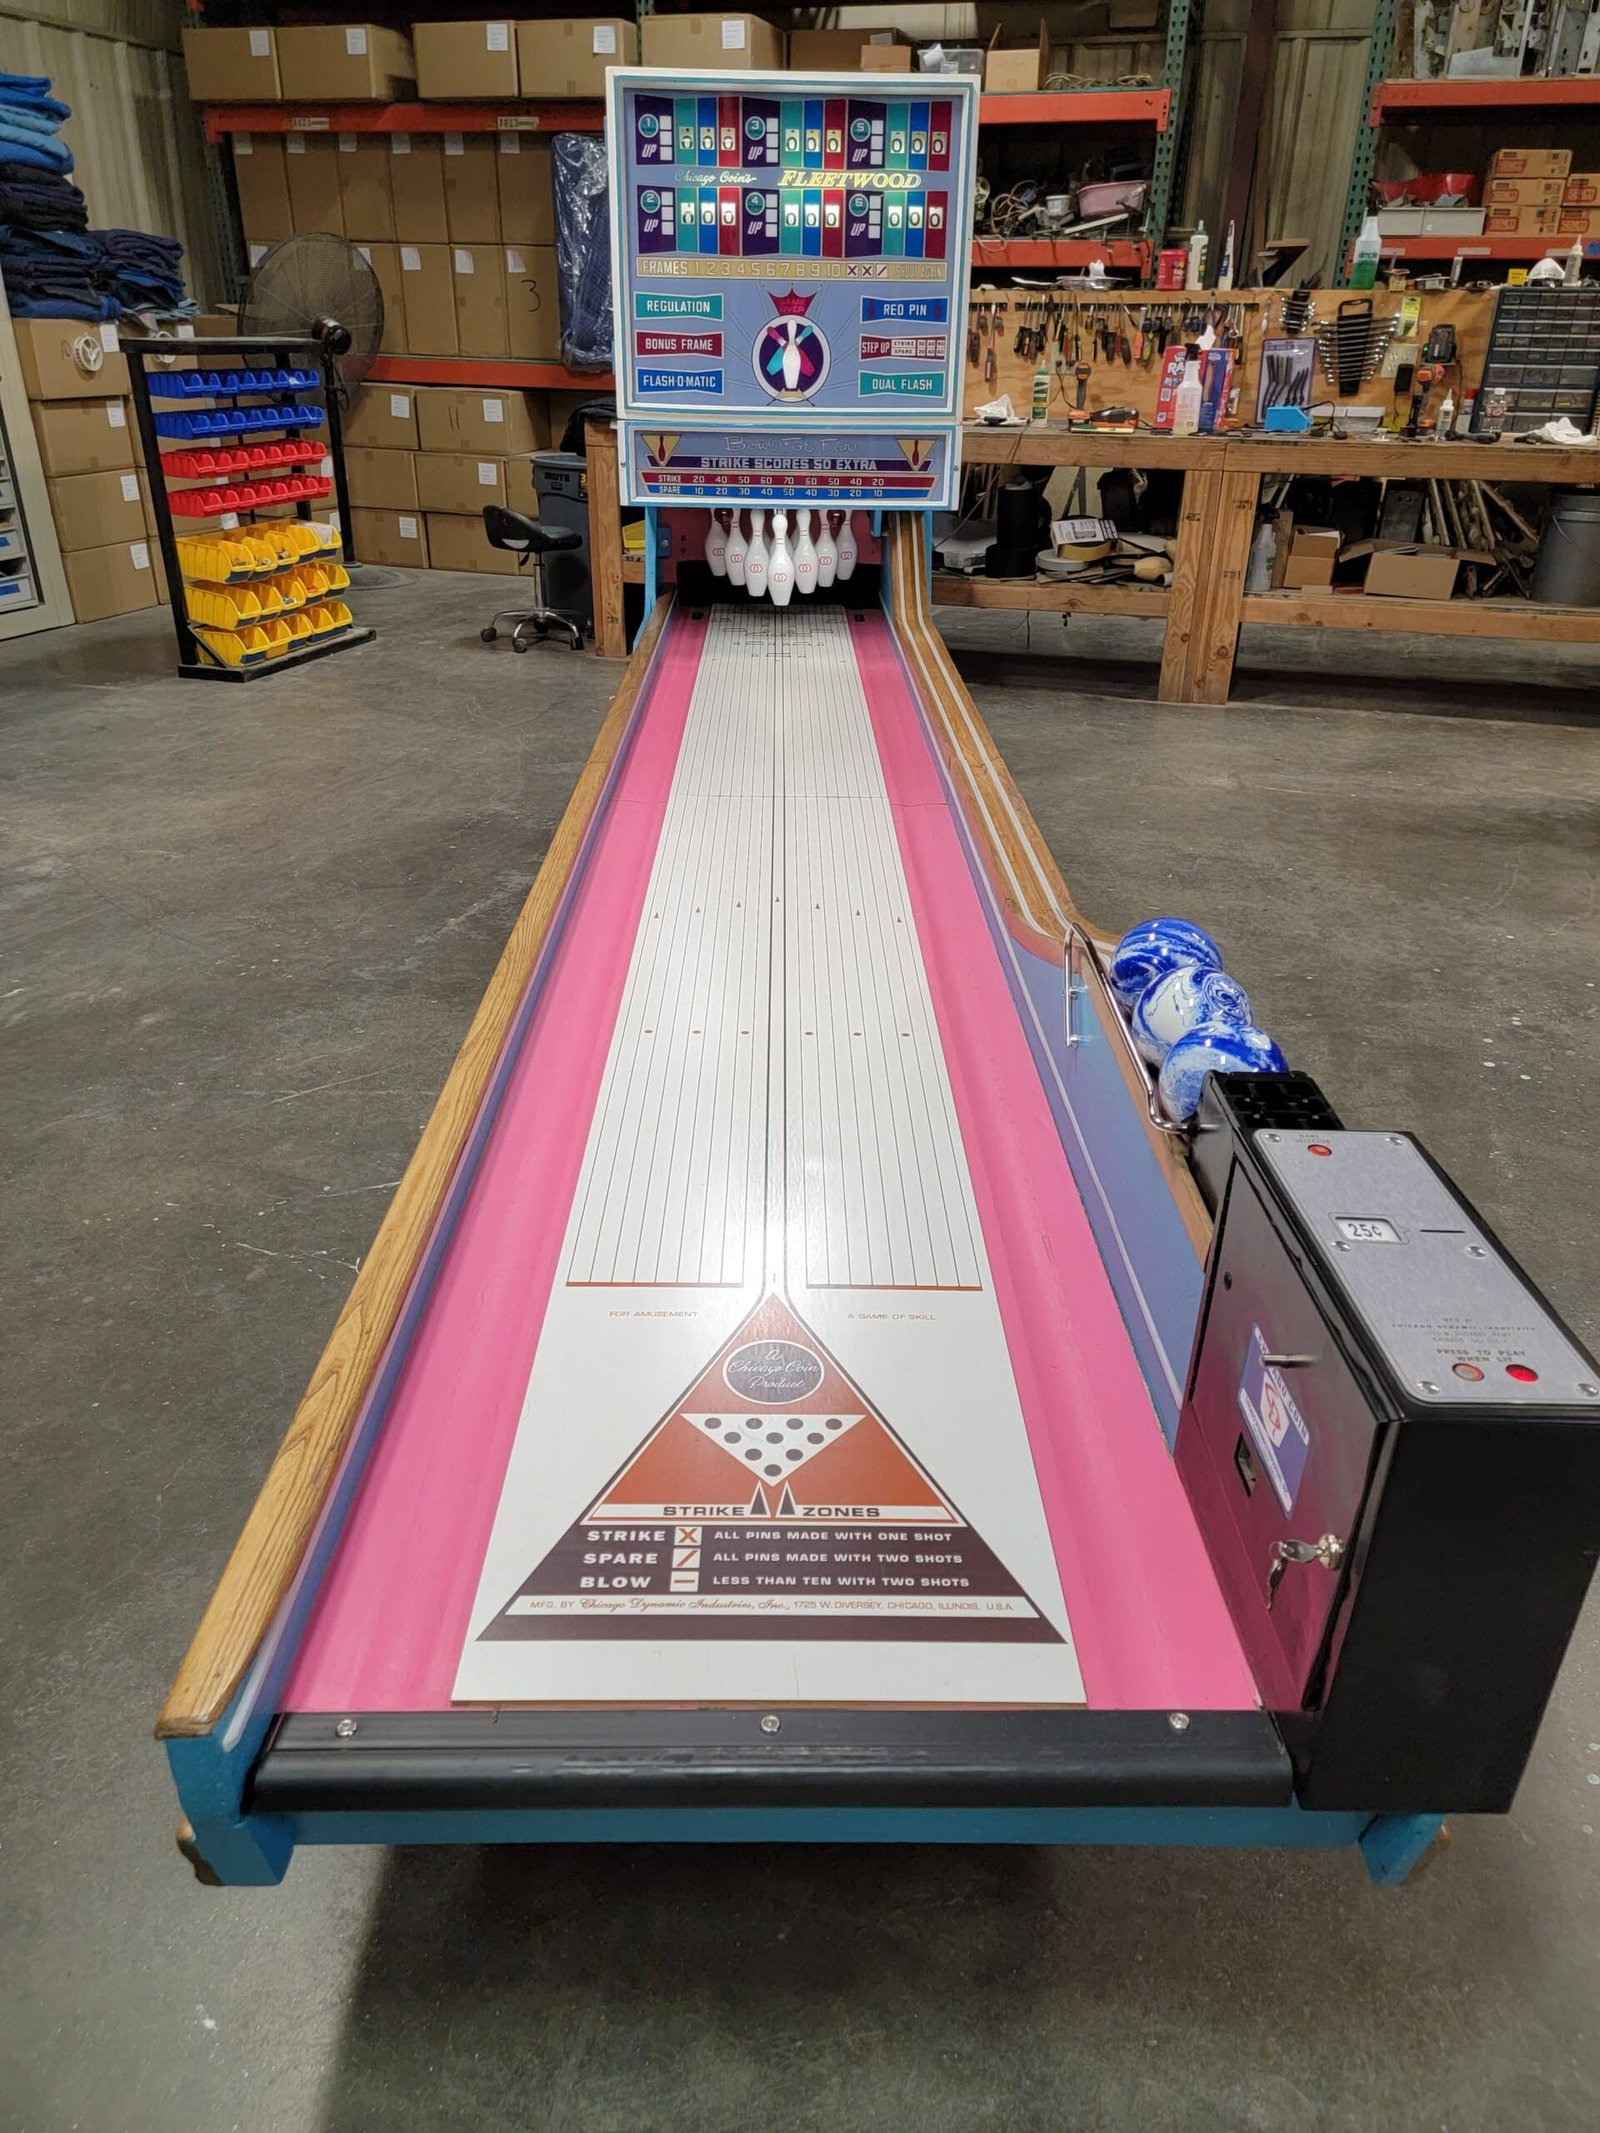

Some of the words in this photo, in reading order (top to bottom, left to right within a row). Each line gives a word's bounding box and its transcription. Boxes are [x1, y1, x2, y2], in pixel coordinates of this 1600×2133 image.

[751, 121, 759, 130] 3
[786, 137, 797, 150] 0
[807, 138, 817, 150] 0
[828, 138, 838, 151] 0
[892, 138, 902, 152] 0
[912, 138, 923, 152] 0
[933, 139, 943, 153] 0
[642, 144, 657, 158] UP
[748, 146, 763, 160] UP
[852, 149, 868, 162] UP
[675, 170, 716, 186] Chicago
[778, 170, 922, 188] FLEETWOOD
[646, 194, 654, 202] 2
[751, 196, 759, 204] 4
[703, 211, 714, 224] 0
[786, 212, 797, 226] 0
[806, 212, 817, 226] 0
[826, 213, 837, 226] 0
[890, 214, 900, 227] 0
[910, 212, 920, 226] 0
[930, 214, 940, 227] 0
[644, 219, 658, 232] UP
[748, 222, 763, 234] UP
[850, 223, 866, 236] UP
[643, 260, 688, 275] FRAMES
[706, 262, 716, 276] 2
[721, 262, 730, 276] 3
[737, 262, 745, 276] 4
[752, 262, 760, 276] 5
[766, 262, 775, 276] 6
[782, 262, 790, 276] 7
[796, 264, 805, 276] 8
[811, 264, 820, 276] 9
[827, 264, 840, 276] 10
[647, 300, 710, 312] REGULATION
[884, 304, 904, 316] RED
[909, 304, 927, 316] PIN
[646, 338, 677, 350] BONUS
[682, 339, 713, 350] FRAME
[862, 342, 879, 354] STEP
[880, 342, 890, 354] UP
[872, 378, 897, 390] DUAL
[901, 378, 932, 390] FLASH
[700, 457, 750, 468] STRIKE
[754, 458, 809, 470] SCORES
[814, 459, 832, 470] 50
[836, 460, 878, 470] EXTRA
[658, 474, 682, 483] STRIKE
[715, 476, 728, 484] 40
[738, 476, 750, 484] 50
[760, 476, 772, 484] 60
[828, 478, 840, 486] 50
[850, 478, 862, 486] 40
[872, 478, 884, 486] 20
[659, 486, 680, 494] SPARE
[739, 488, 750, 496] 30
[760, 488, 772, 496] 40
[783, 488, 794, 496] 50
[805, 488, 818, 496] 40
[828, 489, 840, 497] 30
[850, 489, 862, 497] 20
[874, 489, 882, 497] 10
[1348, 1223, 1382, 1238] 25¢
[728, 1360, 783, 1376] Chicago
[748, 1376, 806, 1388] Product
[663, 1506, 745, 1516] STRIKE
[802, 1507, 880, 1518] ZONES
[586, 1530, 666, 1542] STRIKE
[714, 1532, 740, 1540] ALL
[746, 1532, 781, 1540] PINS
[787, 1532, 828, 1540] MADE
[835, 1532, 872, 1541] WITH
[878, 1533, 908, 1541] ONE
[914, 1533, 952, 1542] SHOT
[583, 1553, 658, 1564] SPARE
[713, 1554, 739, 1562] ALL
[744, 1554, 780, 1562] PINS
[786, 1554, 828, 1562] MADE
[834, 1554, 872, 1562] WITH
[877, 1554, 910, 1563] TWO
[915, 1555, 962, 1564] SHOTS
[580, 1576, 652, 1588] BLOW
[712, 1576, 750, 1585] LESS
[756, 1576, 796, 1586] THAN
[802, 1577, 832, 1586] TEN
[838, 1578, 876, 1586] WITH
[882, 1578, 915, 1586] TWO
[920, 1578, 970, 1587] SHOTS
[580, 1598, 626, 1612] Chicago
[628, 1598, 686, 1612] Dynamic
[688, 1598, 754, 1610] Industries,
[794, 1601, 817, 1609] 1725
